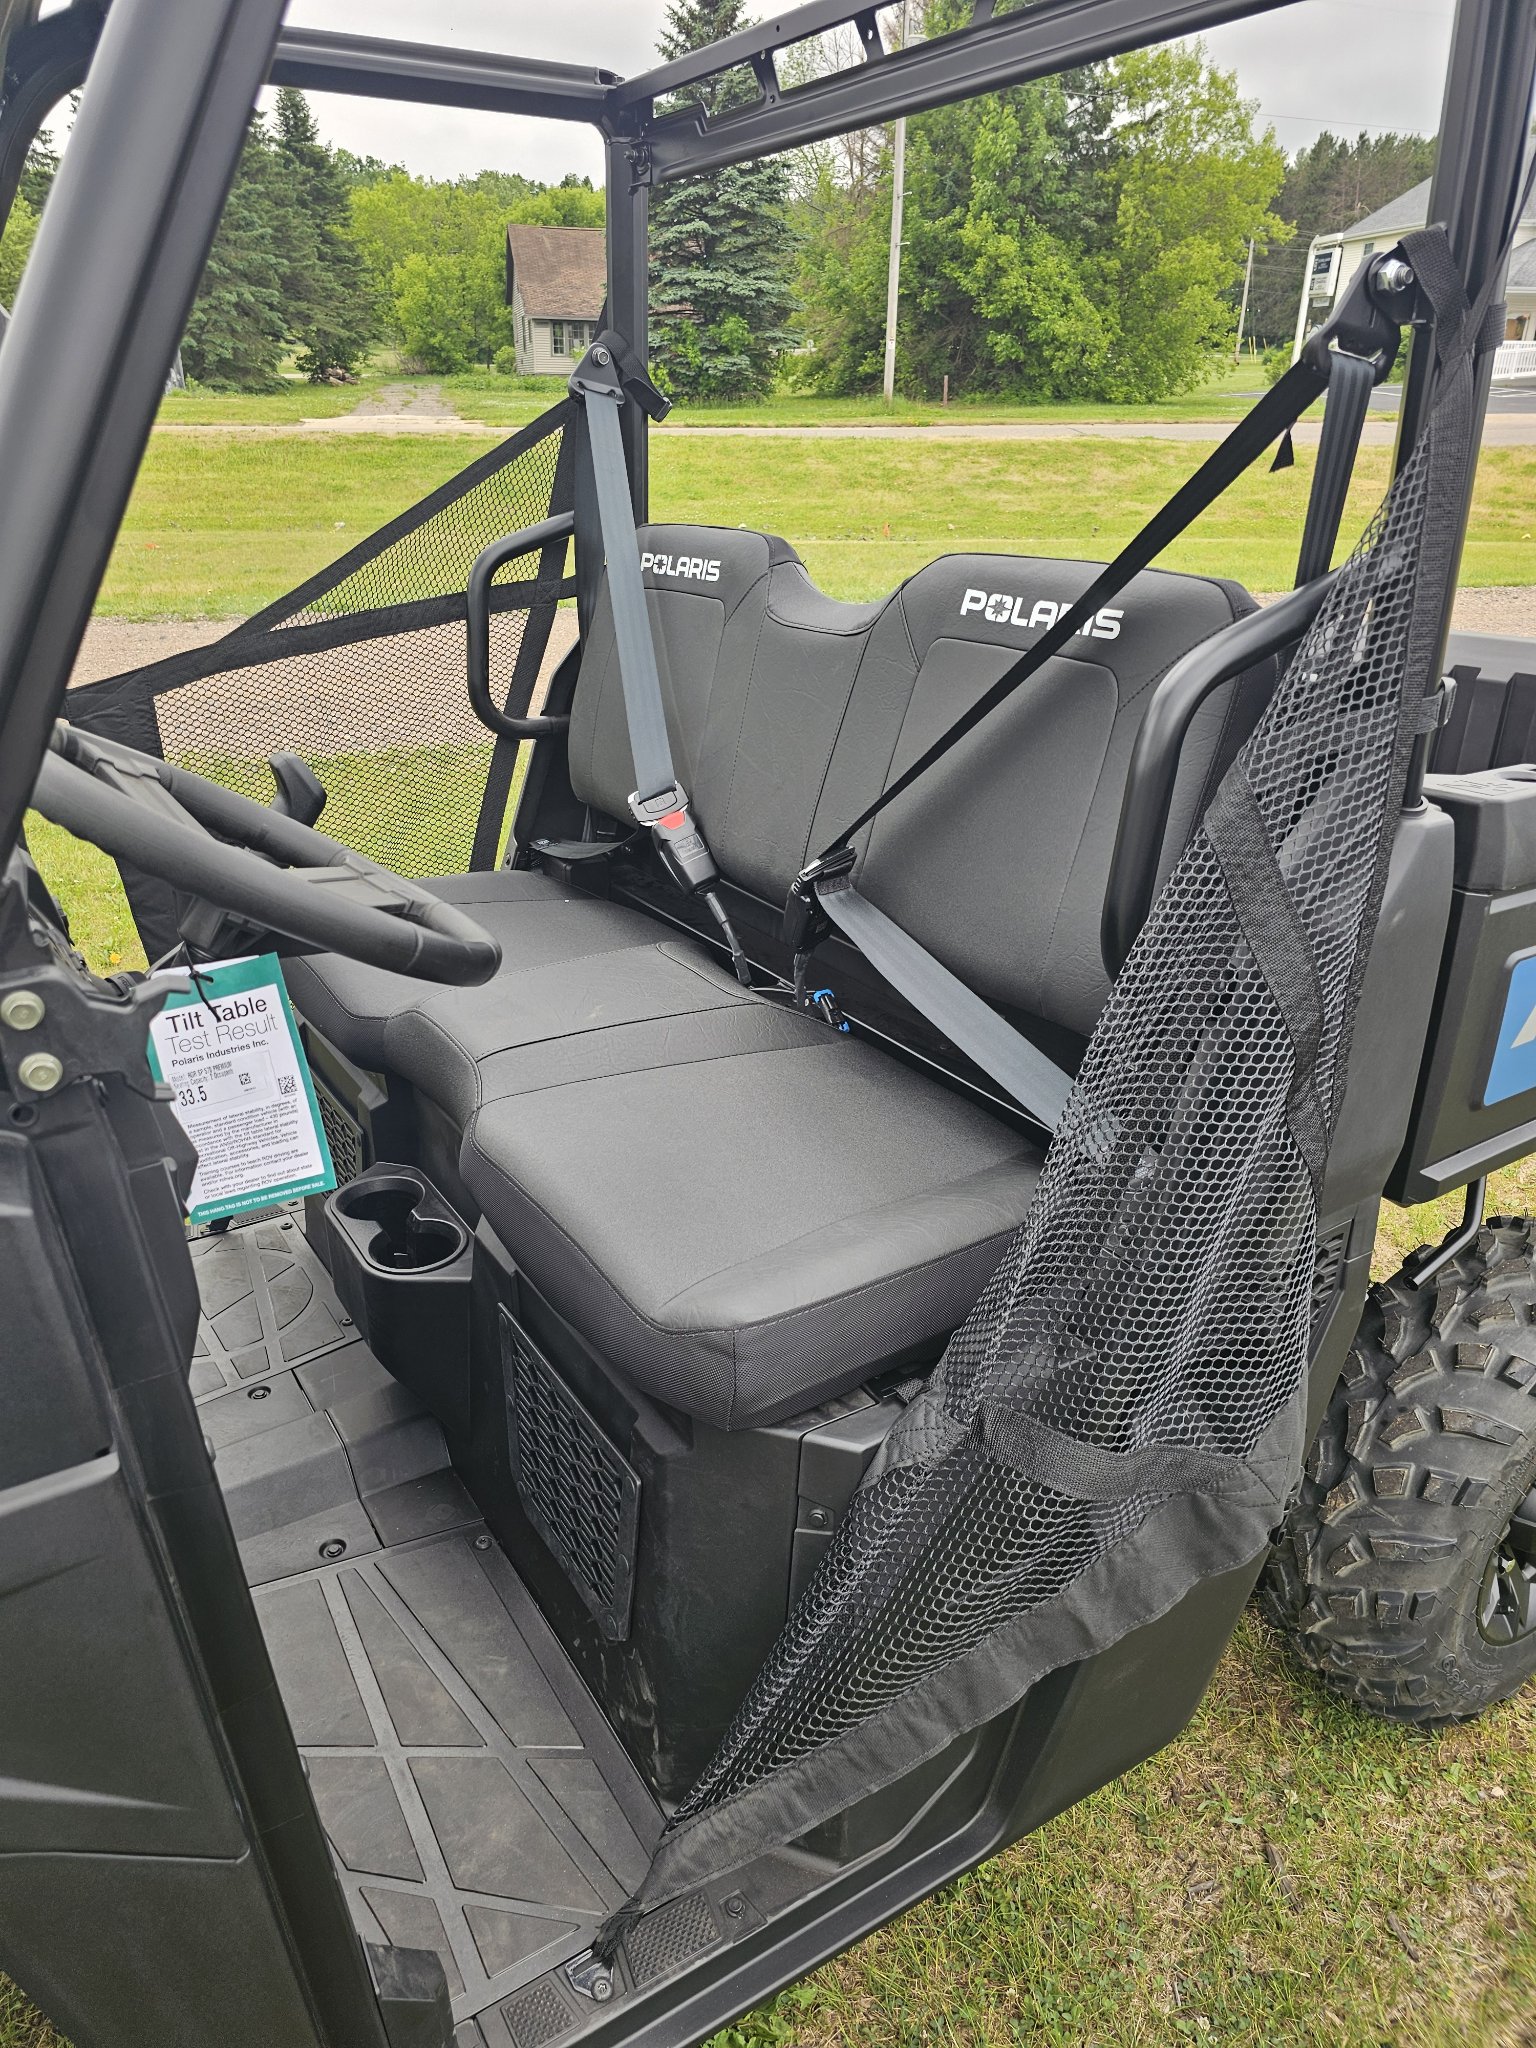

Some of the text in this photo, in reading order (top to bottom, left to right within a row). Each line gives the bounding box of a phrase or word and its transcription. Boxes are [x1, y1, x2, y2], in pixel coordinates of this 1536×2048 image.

[641, 552, 721, 582] POLARIS
[164, 1014, 278, 1055] Test Result
[165, 1011, 204, 1033] Tilt
[171, 1040, 269, 1067] Polaris Industries Inc.
[179, 1085, 207, 1107] 33.5
[209, 1206, 225, 1214] HANG
[268, 1189, 292, 1199] REMOVED
